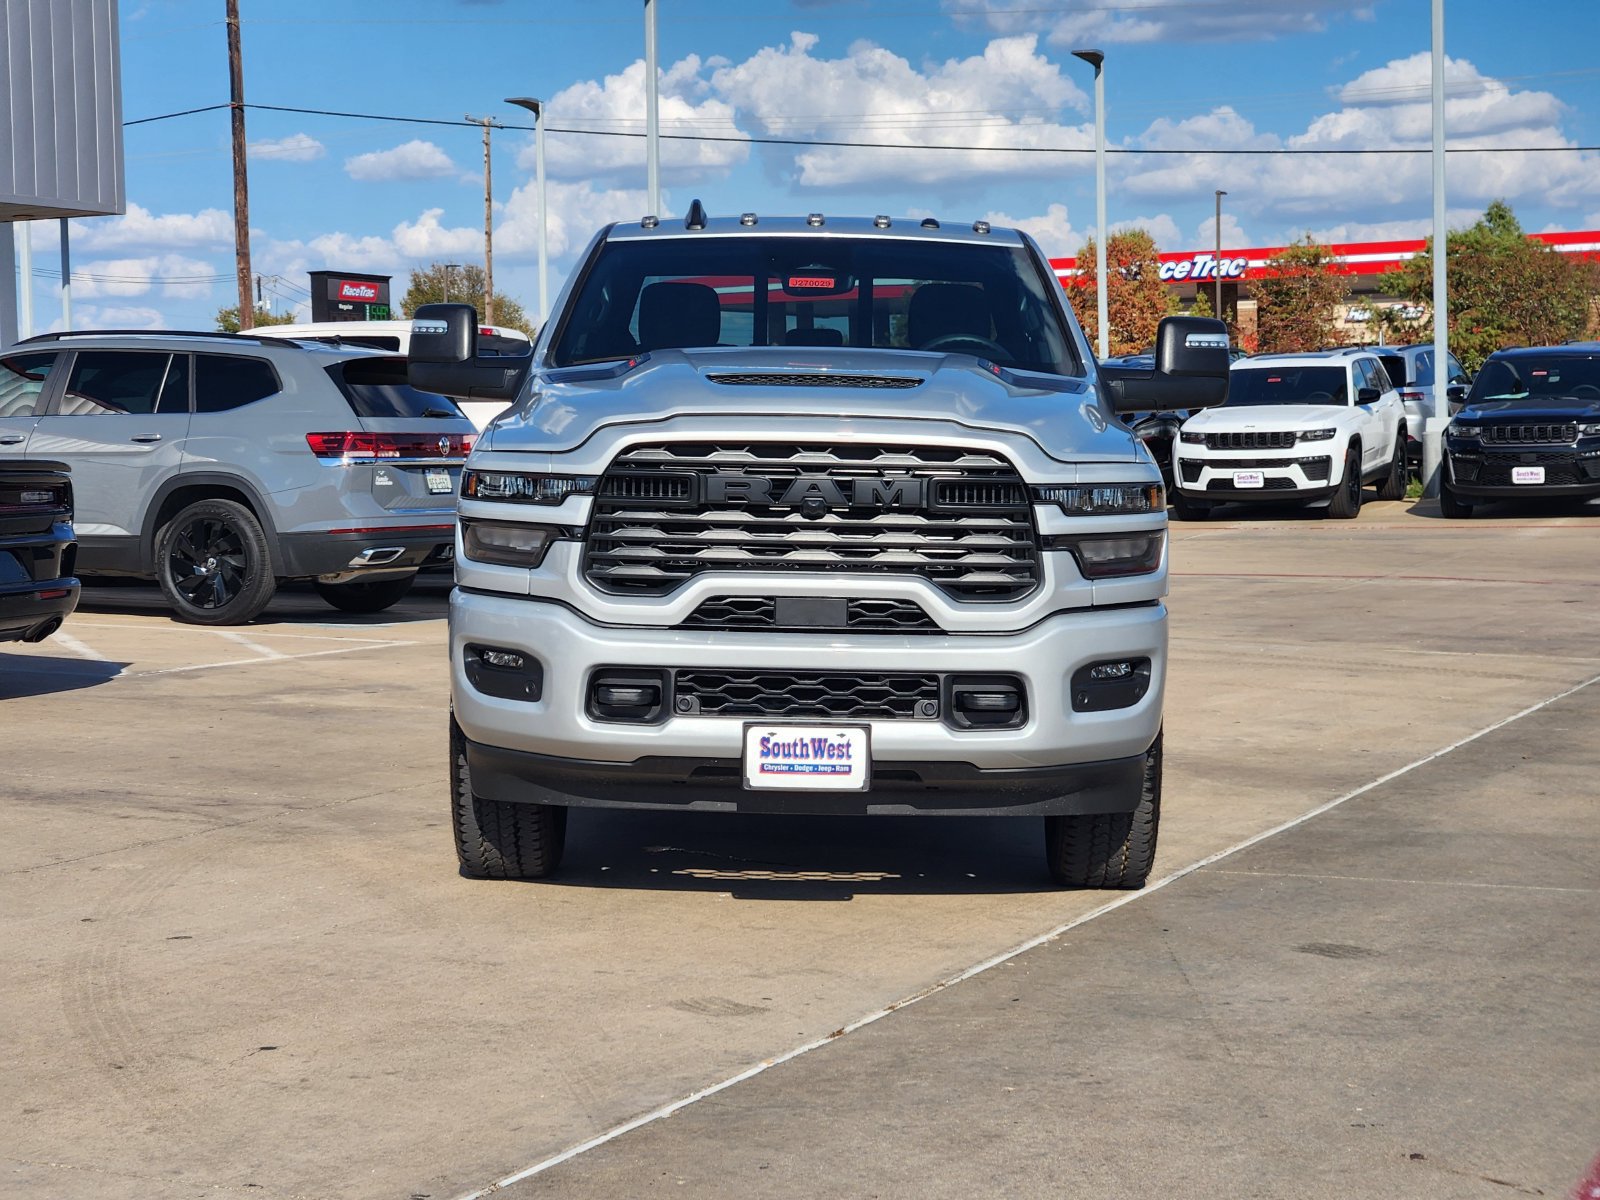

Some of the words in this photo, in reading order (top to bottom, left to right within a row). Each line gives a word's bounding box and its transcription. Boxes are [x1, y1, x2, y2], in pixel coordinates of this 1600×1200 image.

[1158, 254, 1247, 280] ceTrac
[342, 284, 375, 298] RaceTrac
[792, 279, 831, 287] J270029
[706, 474, 923, 507] RAM
[760, 736, 852, 760] SouthWest
[763, 763, 789, 772] Chrysler
[794, 764, 813, 773] Dodge
[818, 765, 832, 773] Jeep
